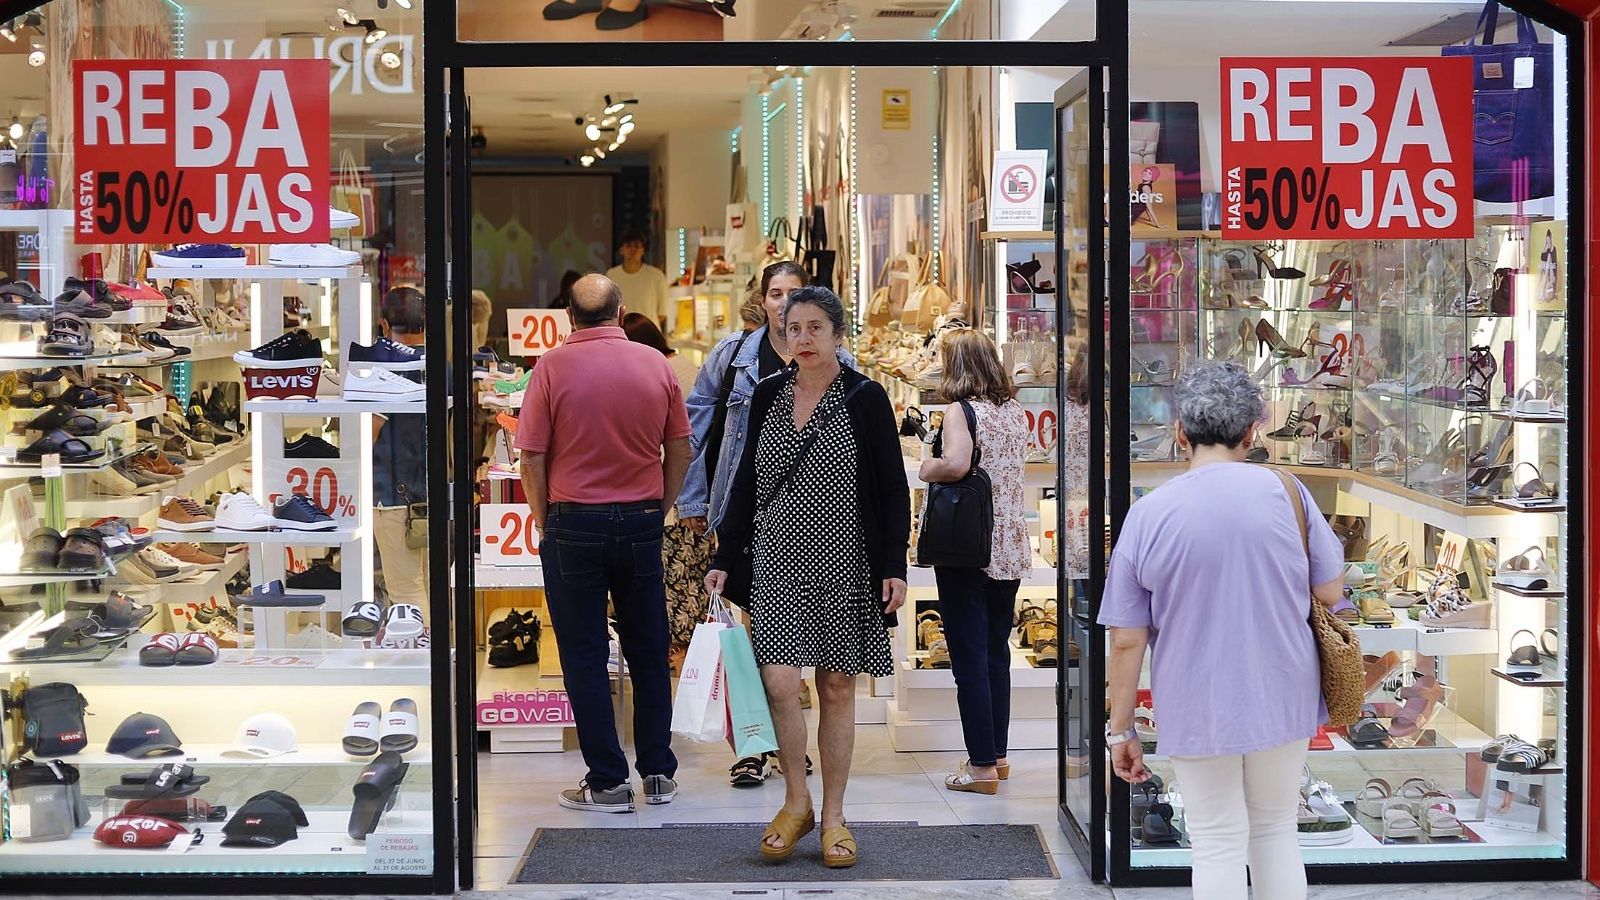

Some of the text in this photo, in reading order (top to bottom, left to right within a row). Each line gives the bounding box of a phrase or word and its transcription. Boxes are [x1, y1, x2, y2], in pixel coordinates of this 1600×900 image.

[80, 169, 94, 234] HASTA
[96, 170, 194, 236] 50%
[197, 172, 314, 234] JAS
[1227, 166, 1341, 231] HASTA 50%
[1343, 168, 1458, 229] JAS
[493, 690, 569, 703] skecher
